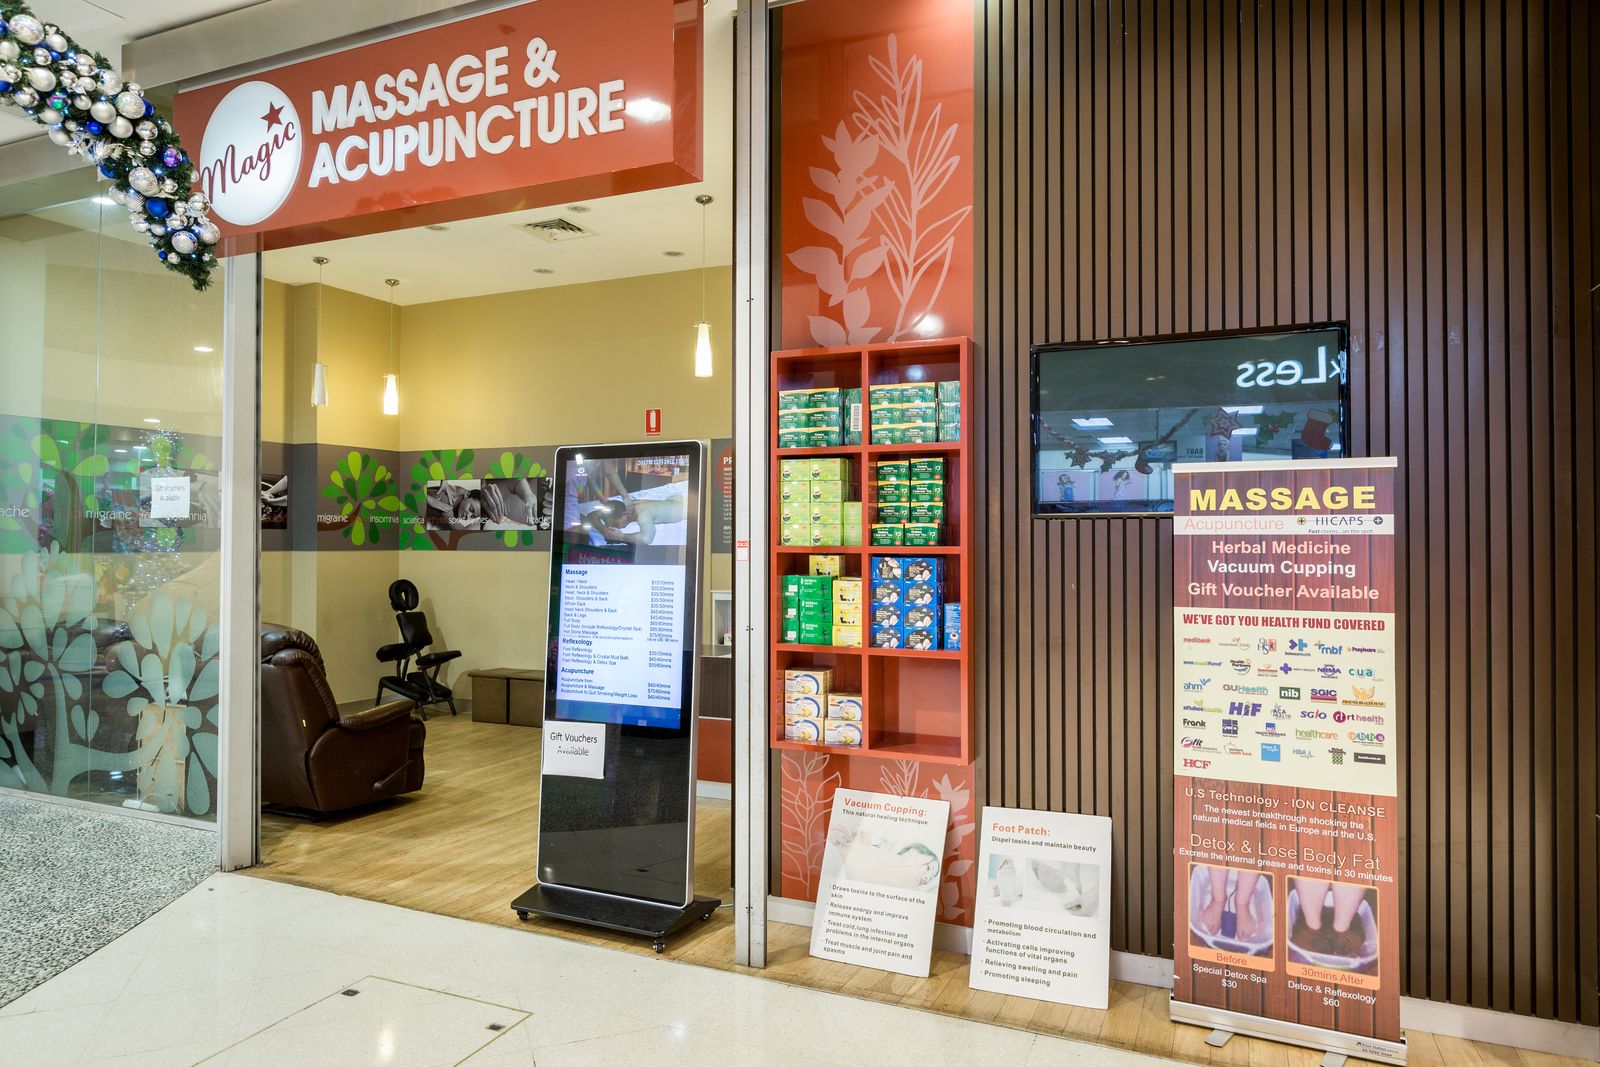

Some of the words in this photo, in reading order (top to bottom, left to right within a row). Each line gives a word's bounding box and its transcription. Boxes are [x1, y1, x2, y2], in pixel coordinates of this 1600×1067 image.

[311, 45, 510, 135] MASSAGE
[524, 36, 560, 89] &
[307, 79, 626, 189] ACUPUNCTURE
[200, 121, 296, 204] Magic
[1189, 485, 1376, 512] MASSAGE
[85, 509, 132, 521] migraine
[316, 513, 349, 524] migraine
[369, 515, 400, 524] insomnia
[1184, 517, 1285, 533] Acupuncture
[1315, 516, 1364, 526] HICAPS
[1211, 540, 1267, 554] Herbal
[1271, 540, 1351, 555] Medicine
[1207, 559, 1275, 574] Vacuum
[1280, 560, 1356, 578] Cupping
[1187, 582, 1217, 596] Gift
[1222, 583, 1293, 598] Voucher
[1296, 584, 1380, 600] Available
[1183, 613, 1213, 626] WE'VE
[1215, 614, 1236, 627] GOT
[1238, 615, 1259, 627] YOU
[1261, 616, 1300, 628] HEALTH
[1302, 618, 1331, 629] FUND
[1333, 618, 1385, 631] COVERED
[563, 638, 592, 646] Reflexology
[1321, 645, 1343, 655] mbf
[1183, 682, 1203, 690] ahm
[1281, 689, 1299, 698] nib
[1310, 688, 1337, 696] SGIC
[1183, 719, 1206, 727] Frank
[550, 732, 563, 741] Gift
[564, 733, 598, 743] Vouchers
[557, 746, 589, 756] Available
[1183, 758, 1211, 769] HCF
[844, 798, 882, 810] Vacuum
[884, 803, 927, 817] Cupping:
[1185, 787, 1205, 799] U.S
[1209, 790, 1279, 807] Technology
[1292, 799, 1315, 810] ION
[1320, 801, 1386, 818] CLEANSE
[876, 813, 898, 822] healing
[898, 816, 928, 825] technique
[1204, 804, 1219, 814] The
[1221, 807, 1250, 817] newest
[1252, 810, 1307, 824] breakthrough
[1309, 816, 1348, 829] shocking
[1349, 820, 1364, 830] the
[993, 823, 1015, 833] Foot
[1018, 825, 1051, 837] Patch:
[1192, 814, 1220, 824] natural
[1222, 817, 1253, 827] medical
[1255, 820, 1278, 830] fields
[1279, 822, 1287, 830] in
[1289, 824, 1319, 836] Europe
[1321, 828, 1339, 837] and
[1340, 830, 1355, 839] the
[1357, 832, 1377, 842] U.S.
[991, 836, 1011, 845] Dispel
[1011, 838, 1030, 846] toxins
[1044, 841, 1073, 850] maintain
[1073, 844, 1097, 853] beauty
[1190, 833, 1236, 852] Detox
[1241, 840, 1252, 854] &
[1258, 843, 1297, 860] Lose
[1303, 848, 1347, 869] Body
[1352, 854, 1381, 871] Fat
[1179, 848, 1208, 859] Excrete
[1210, 851, 1224, 861] the
[1225, 853, 1256, 865] internal
[1257, 858, 1286, 870] grease
[1288, 862, 1304, 871] and
[1306, 864, 1332, 875] toxins
[1334, 867, 1342, 876] in
[1344, 869, 1356, 878] 30
[1357, 871, 1394, 884] minutes
[832, 885, 850, 893] Draws
[850, 888, 868, 896] toxins
[828, 910, 850, 919] immune
[852, 914, 872, 922] system
[830, 902, 852, 910] Release
[853, 906, 872, 915] energy
[885, 911, 909, 920] improve
[870, 927, 895, 937] infection
[987, 927, 1022, 937] metabolism
[988, 919, 1023, 930] Promoting
[1023, 924, 1044, 932] blood
[1044, 926, 1082, 937] circulation
[826, 928, 853, 937] problems
[870, 935, 893, 944] internal
[893, 940, 914, 948] organs
[823, 946, 846, 955] spasms
[825, 939, 839, 947] Treat
[840, 942, 860, 950] muscle
[861, 945, 872, 953] and
[872, 946, 887, 955] joint
[887, 950, 900, 959] pain
[901, 952, 913, 960] and
[985, 946, 1018, 957] functions
[1026, 952, 1042, 960] vital
[1043, 955, 1068, 964] organs
[986, 939, 1021, 950] Activating
[1022, 944, 1038, 952] cells
[1039, 946, 1075, 958] improving
[1216, 952, 1248, 967] Before
[985, 958, 1017, 970] Relieving
[1018, 963, 1047, 975] swelling
[1047, 968, 1061, 976] and
[1062, 970, 1078, 979] pain
[1193, 963, 1223, 977] Special
[1224, 968, 1249, 980] Detox
[1250, 974, 1268, 985] Spa
[1302, 967, 1338, 982] 30mins
[1341, 972, 1364, 986] After
[984, 969, 1020, 982] Promoting
[1020, 975, 1051, 987] sleeping
[1221, 978, 1238, 989] $30
[1287, 980, 1314, 993] Detox
[1315, 985, 1323, 994] &
[1324, 987, 1377, 1005] Reflexology
[1323, 997, 1340, 1008] $60
